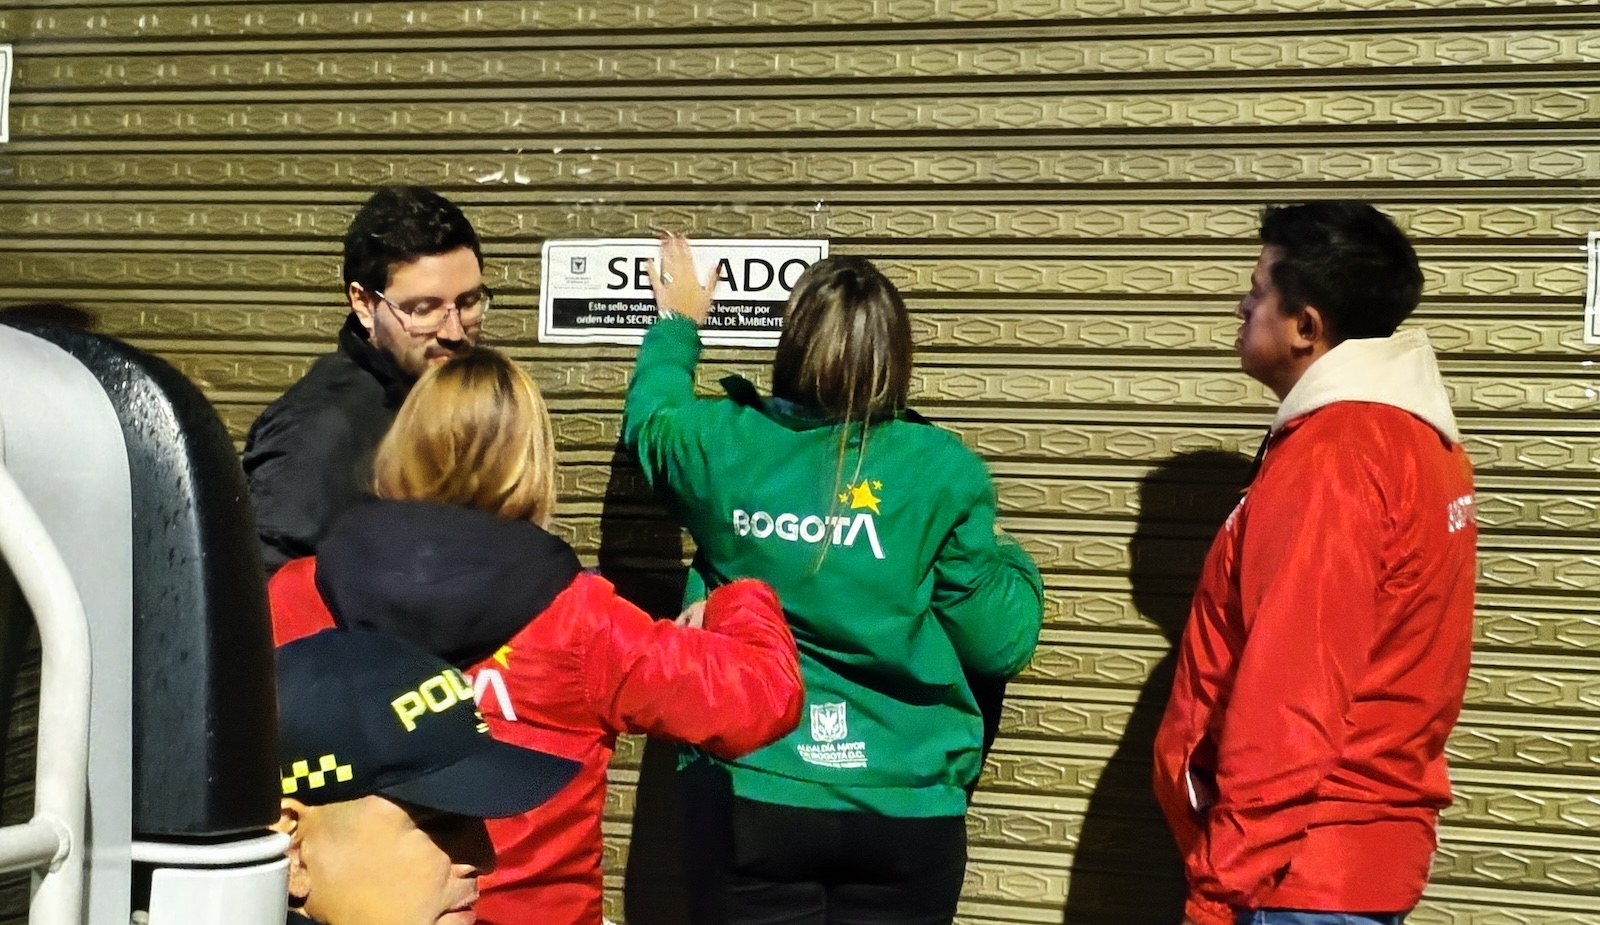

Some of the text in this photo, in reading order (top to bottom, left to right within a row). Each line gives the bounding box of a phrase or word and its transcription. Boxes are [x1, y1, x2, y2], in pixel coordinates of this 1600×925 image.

[606, 256, 811, 292] SEADO
[588, 302, 607, 312] Este
[608, 302, 629, 312] sello
[629, 302, 656, 312] solam
[717, 303, 753, 314] levantar
[754, 305, 771, 316] por
[576, 314, 784, 328] orden de la SECRET ITAL DE AMBIENTE
[391, 669, 475, 732] POL
[837, 742, 865, 751] MAYOR
